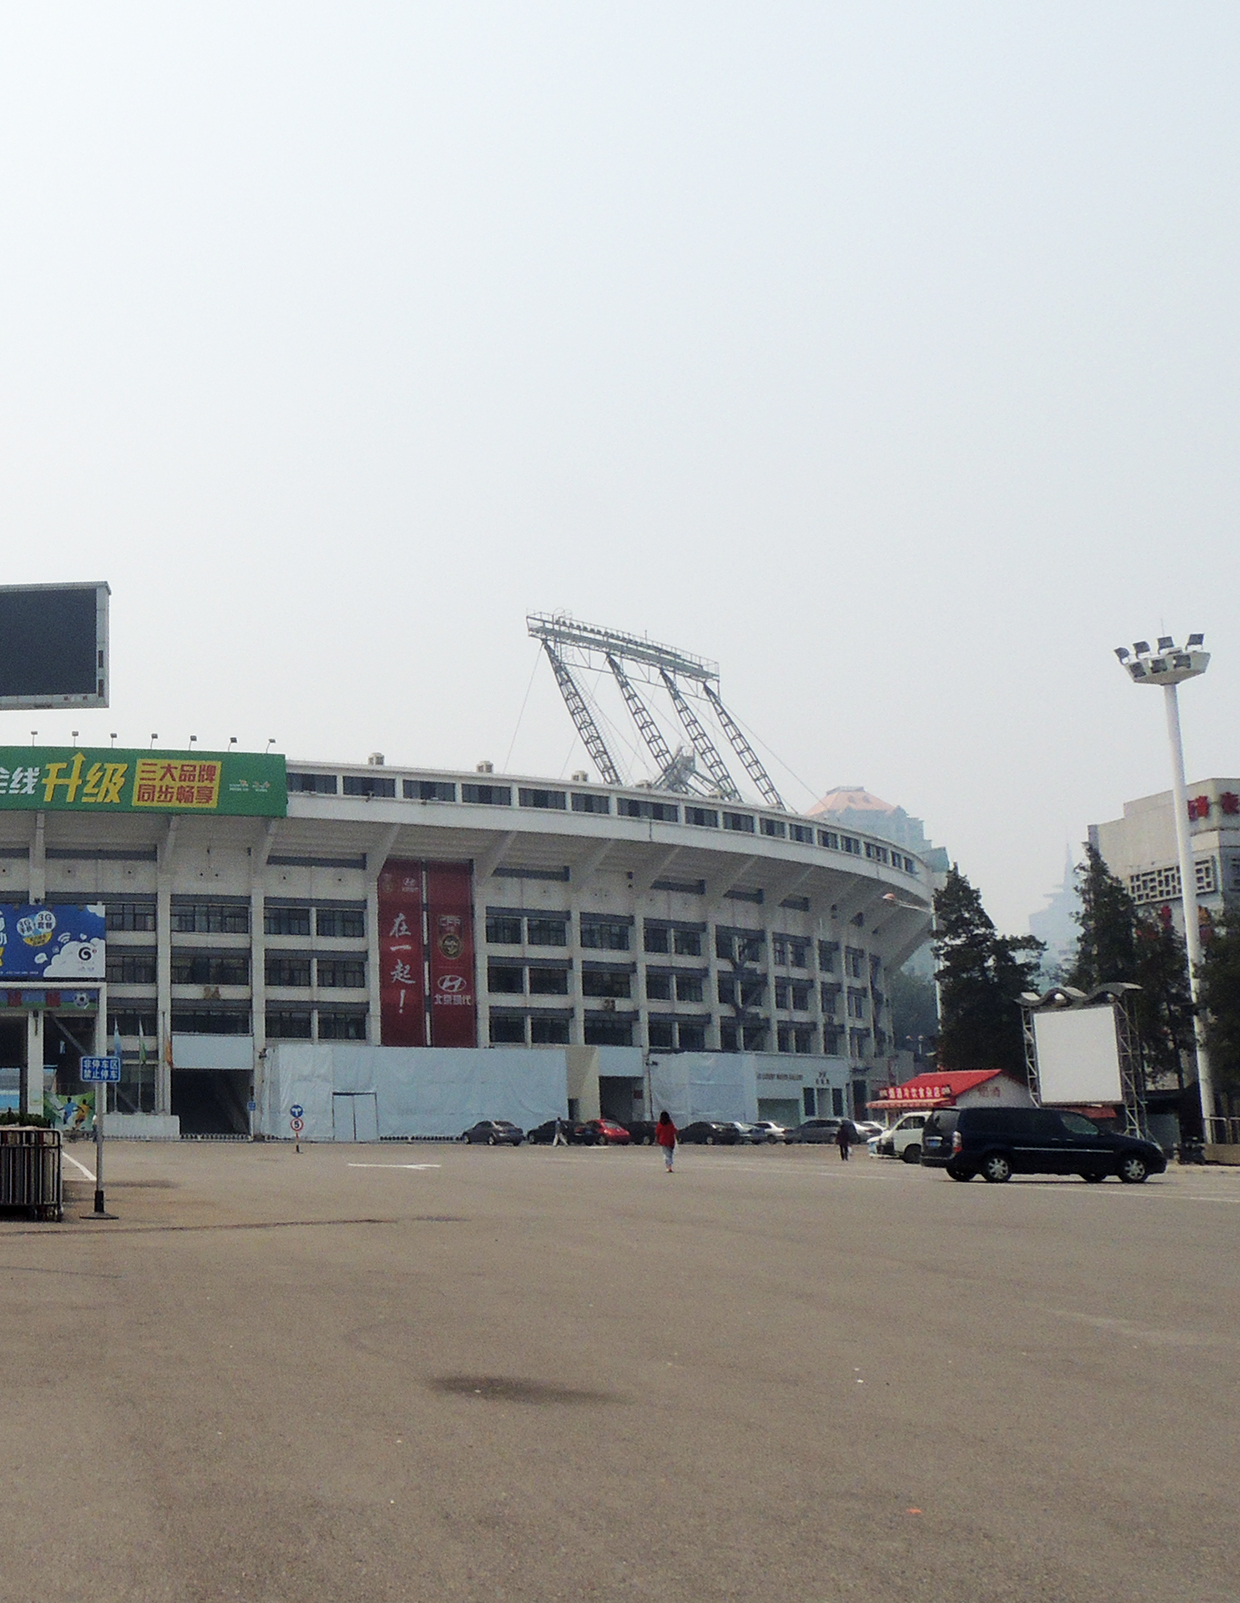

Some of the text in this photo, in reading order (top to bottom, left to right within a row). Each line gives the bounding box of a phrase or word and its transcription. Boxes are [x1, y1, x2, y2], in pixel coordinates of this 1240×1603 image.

[140, 762, 217, 784] 三大品牌
[136, 783, 215, 804] 同步畅享
[38, 913, 52, 921] 3G
[83, 1059, 118, 1069] 非停车区
[83, 1069, 118, 1079] 禁止停车
[293, 1120, 300, 1128] 5
